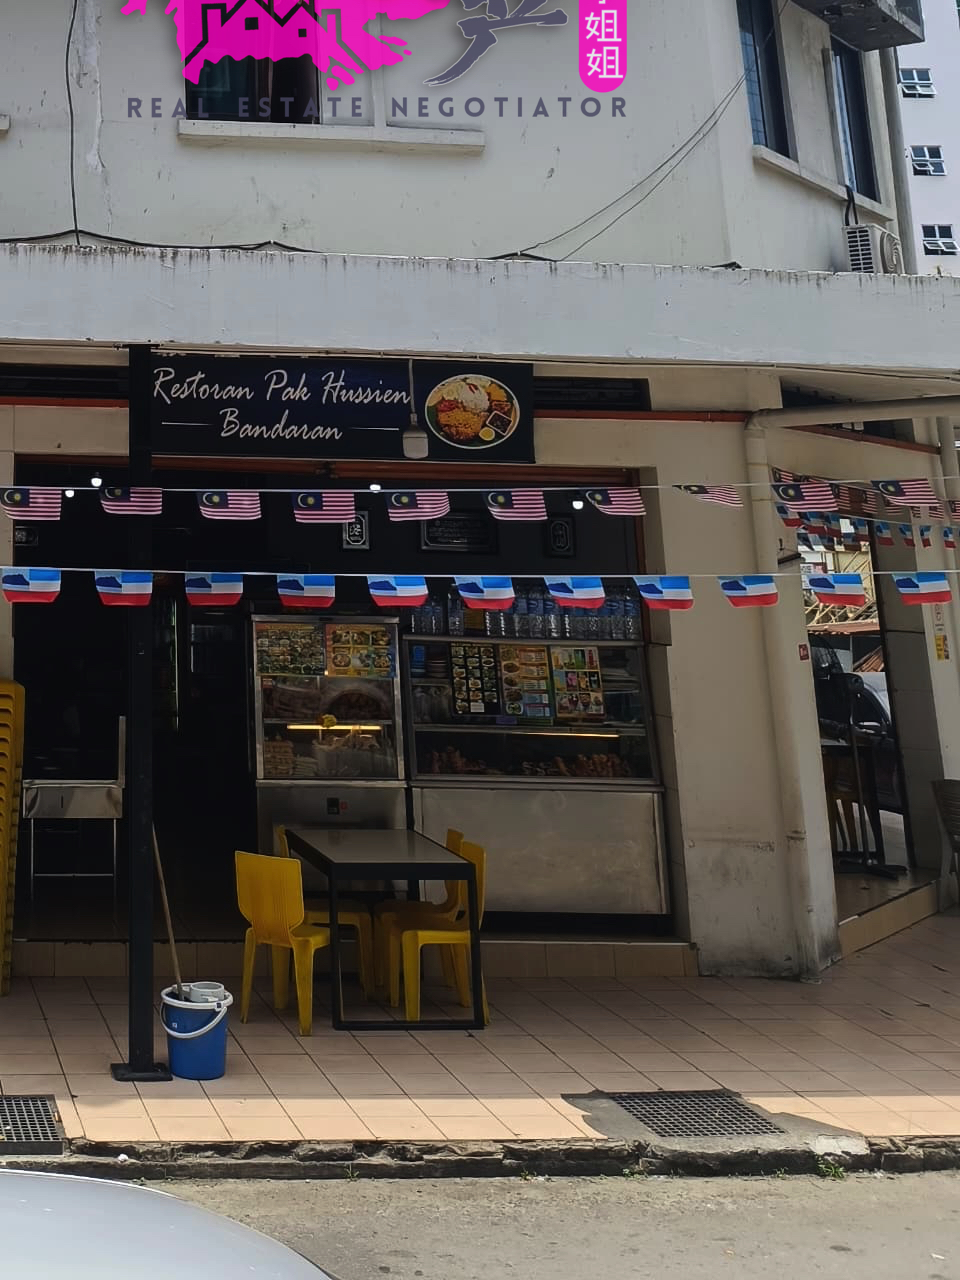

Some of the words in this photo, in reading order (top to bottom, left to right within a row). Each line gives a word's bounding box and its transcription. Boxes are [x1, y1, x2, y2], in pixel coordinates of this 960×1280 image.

[153, 367, 255, 405] Restoran
[264, 369, 311, 402] Pak
[321, 369, 412, 405] Hussien
[219, 407, 343, 440] Bandaran
